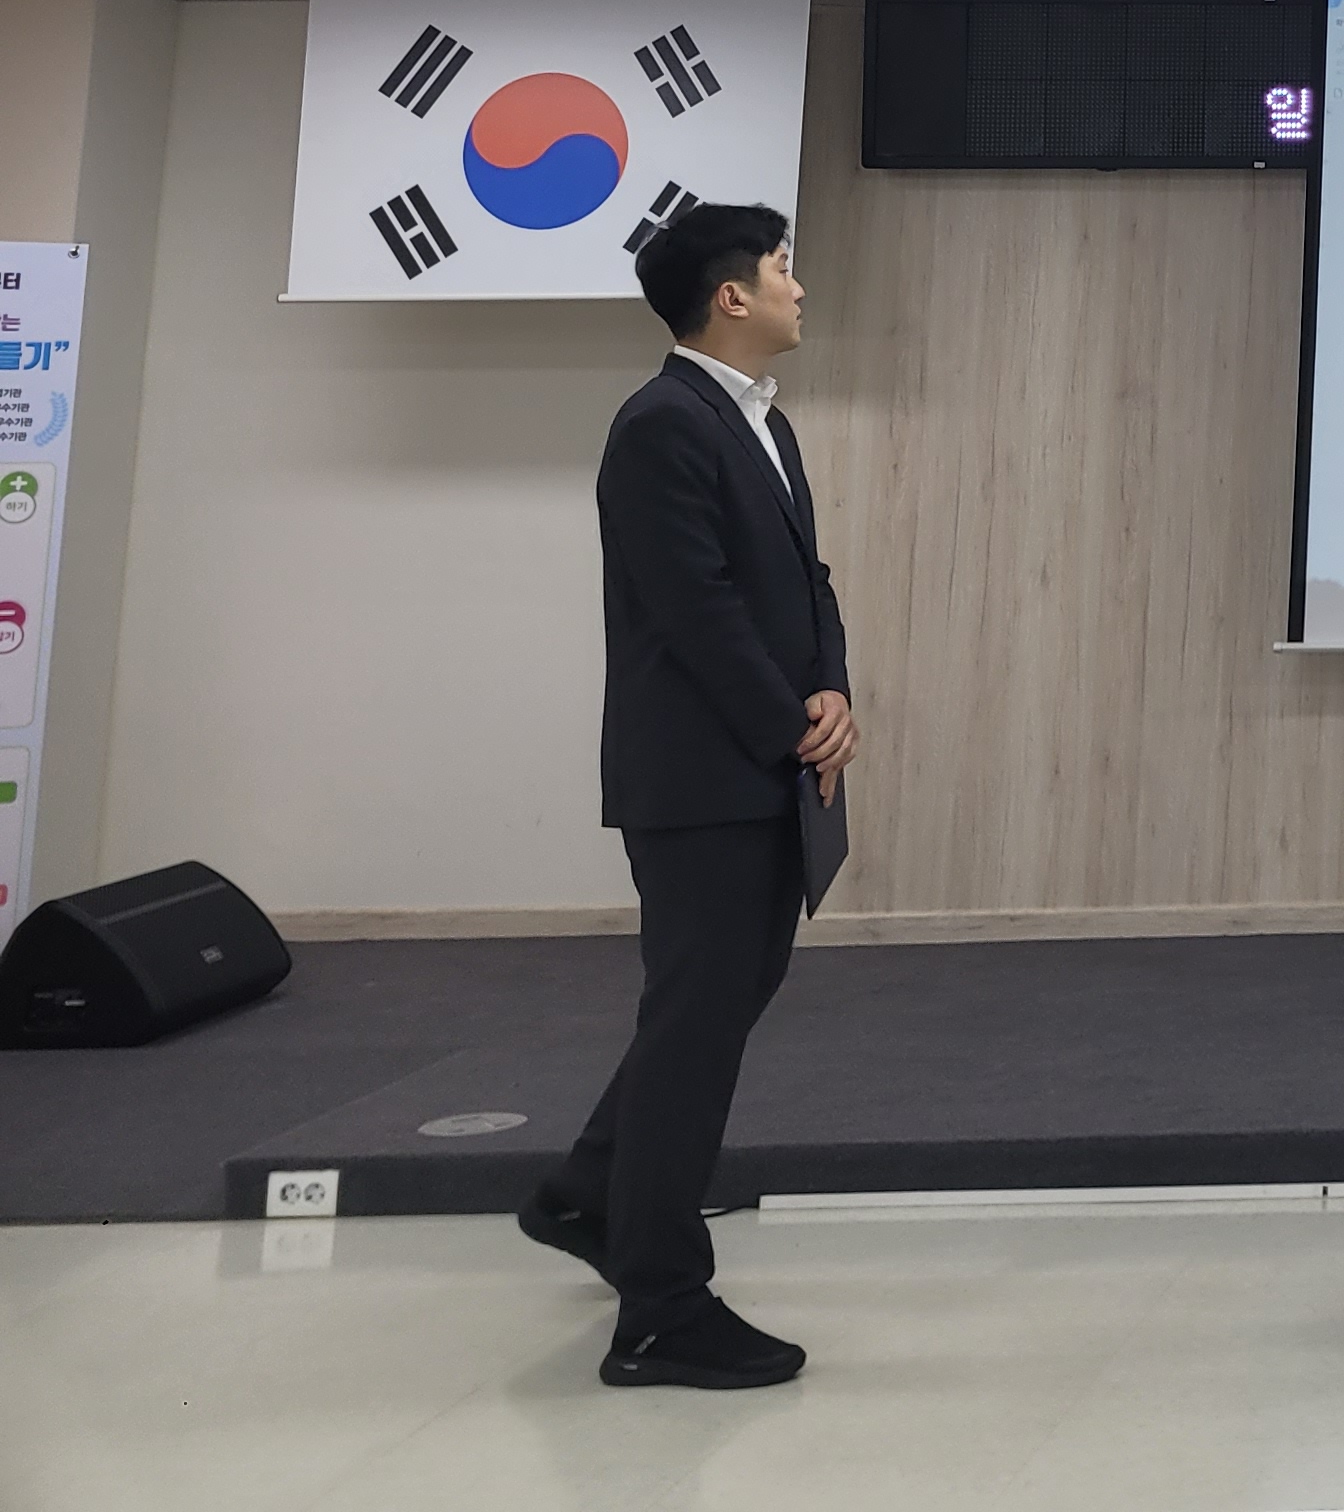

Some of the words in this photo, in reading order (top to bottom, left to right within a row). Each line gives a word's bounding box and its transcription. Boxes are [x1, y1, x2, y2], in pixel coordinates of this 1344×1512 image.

[1265, 88, 1307, 139] 일
[0, 272, 21, 290] 터
[0, 313, 21, 332] 는
